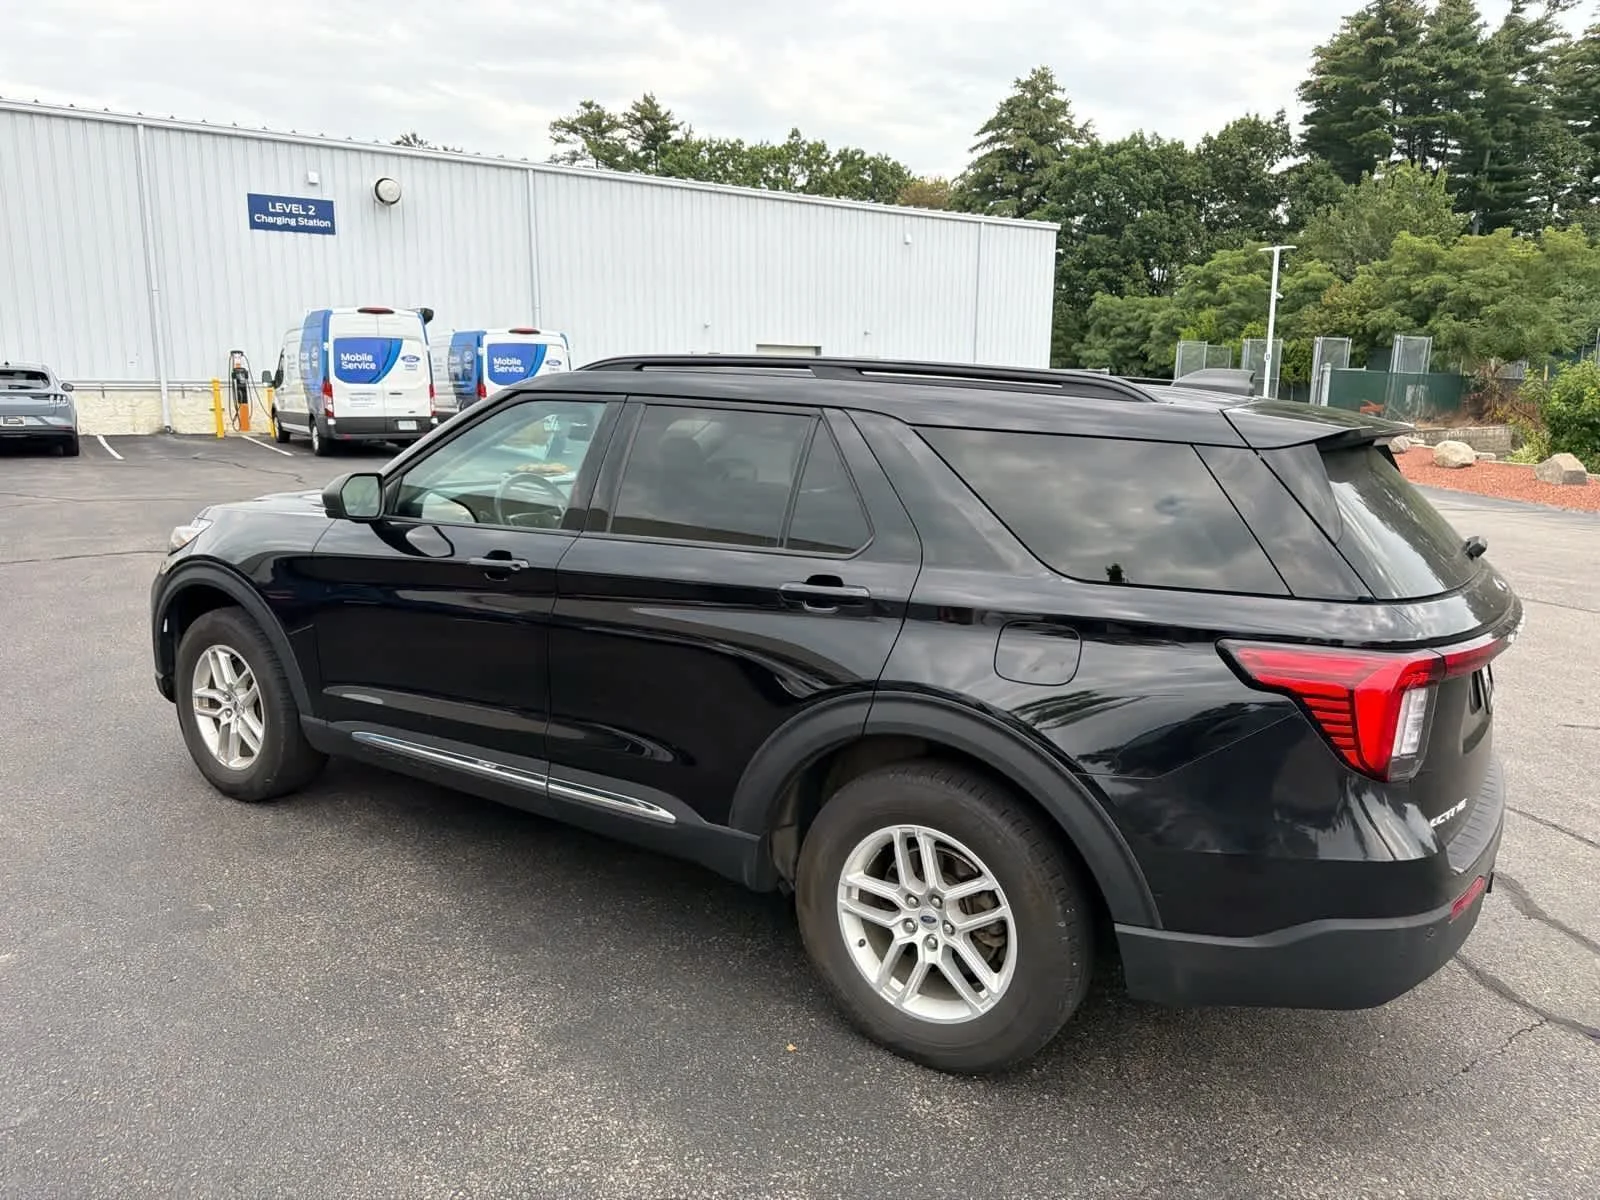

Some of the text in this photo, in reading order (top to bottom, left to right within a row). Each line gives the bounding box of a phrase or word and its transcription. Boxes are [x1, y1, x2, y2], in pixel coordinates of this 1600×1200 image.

[268, 201, 316, 216] LEVEL 2
[254, 214, 331, 228] Charging Station
[340, 352, 373, 362] Mobile
[493, 357, 522, 366] Mobile
[341, 361, 377, 370] Service
[494, 365, 525, 373] Service
